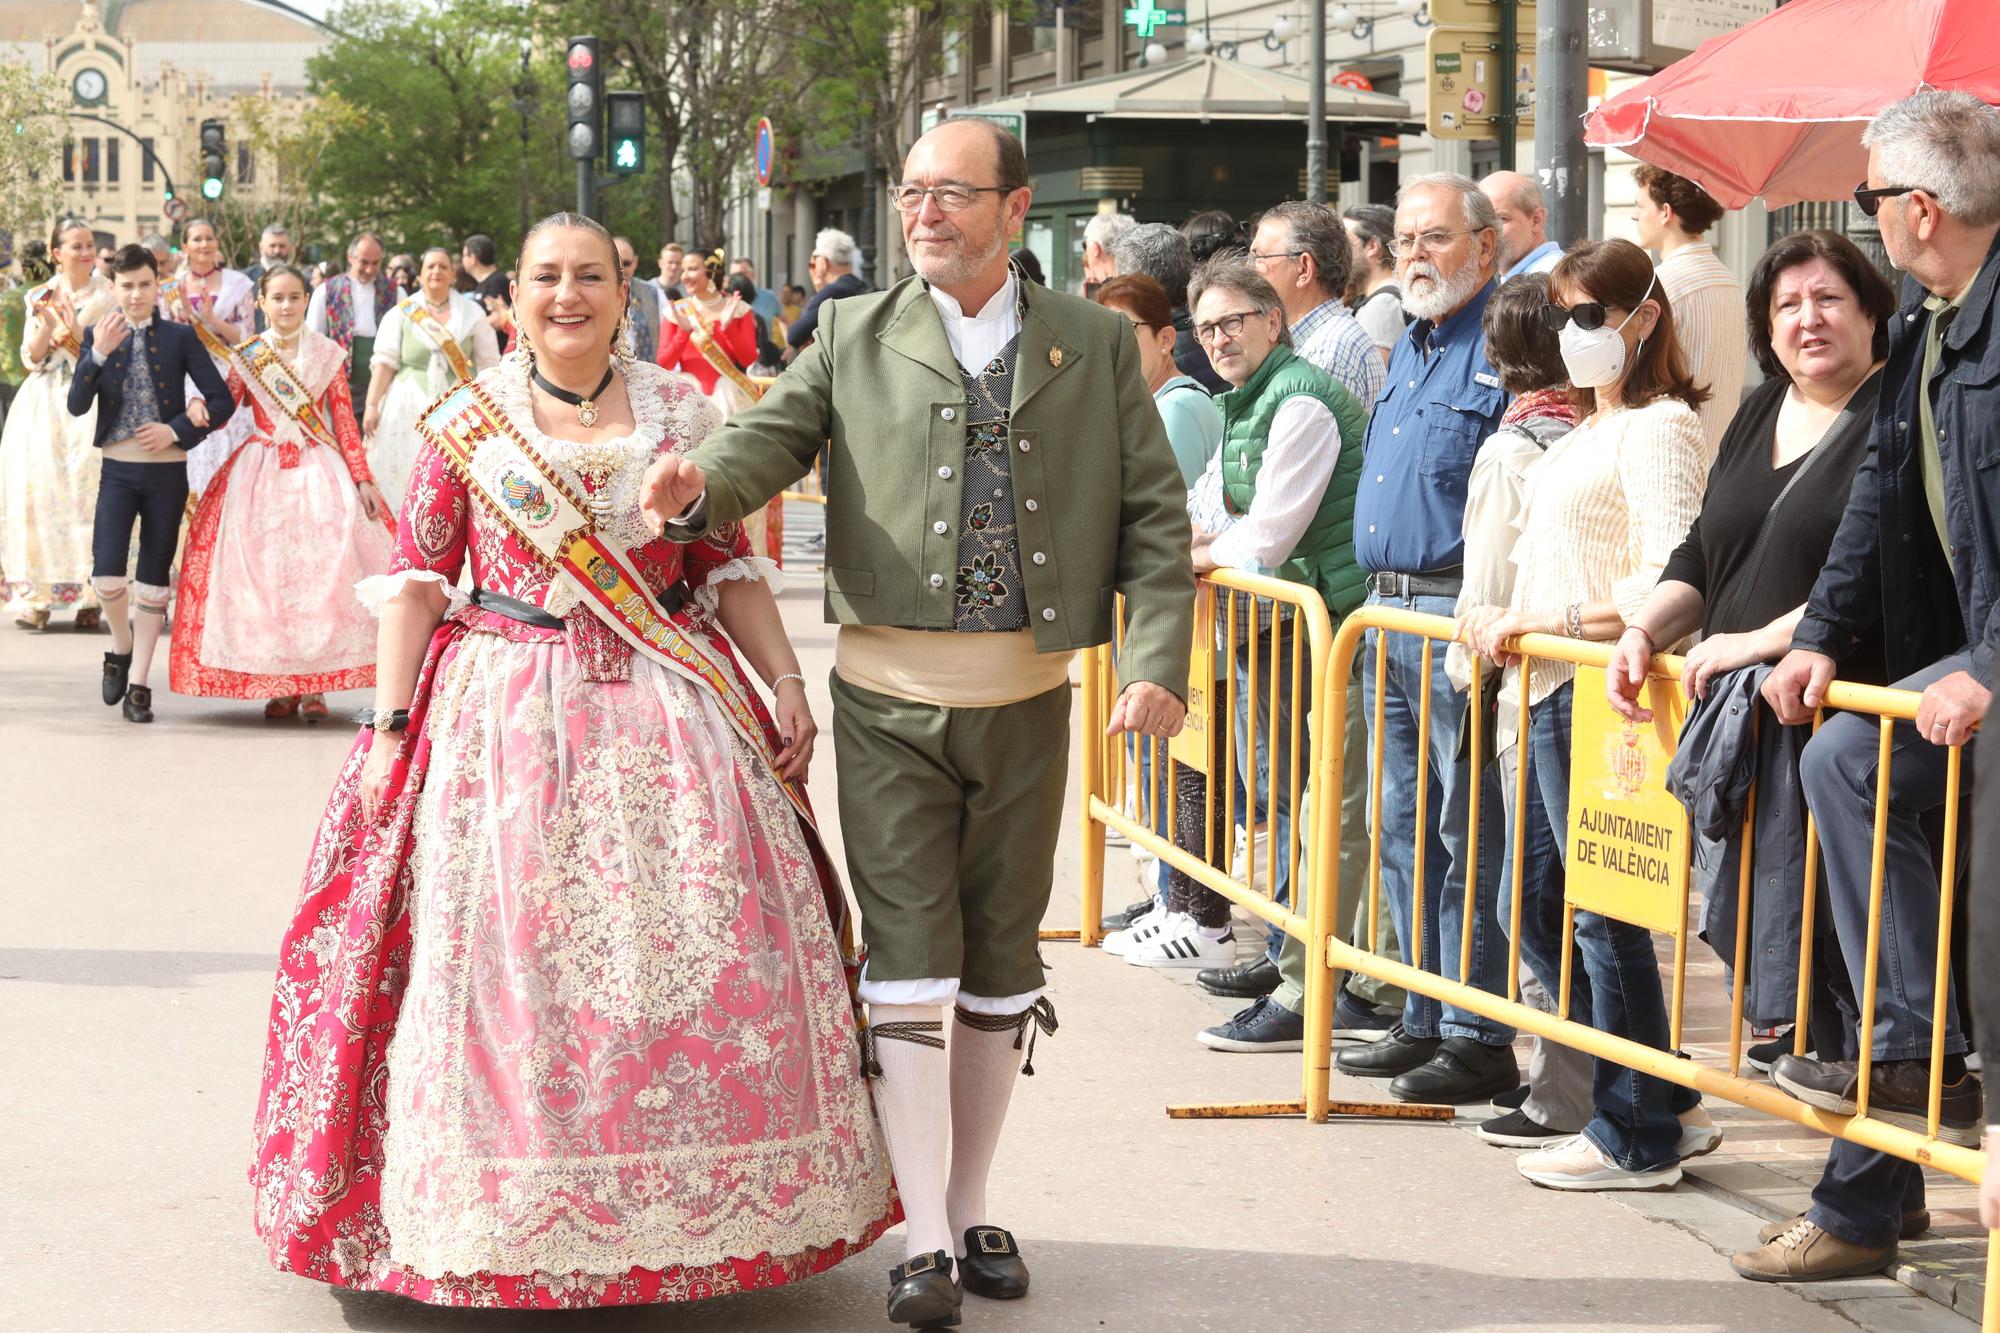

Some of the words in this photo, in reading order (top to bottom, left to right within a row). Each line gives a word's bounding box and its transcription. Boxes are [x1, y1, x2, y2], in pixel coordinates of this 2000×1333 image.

[1579, 807, 1673, 852] AJUNTAMENT
[1577, 838, 1598, 865] DE
[1602, 844, 1670, 886] VALÈNCIA
